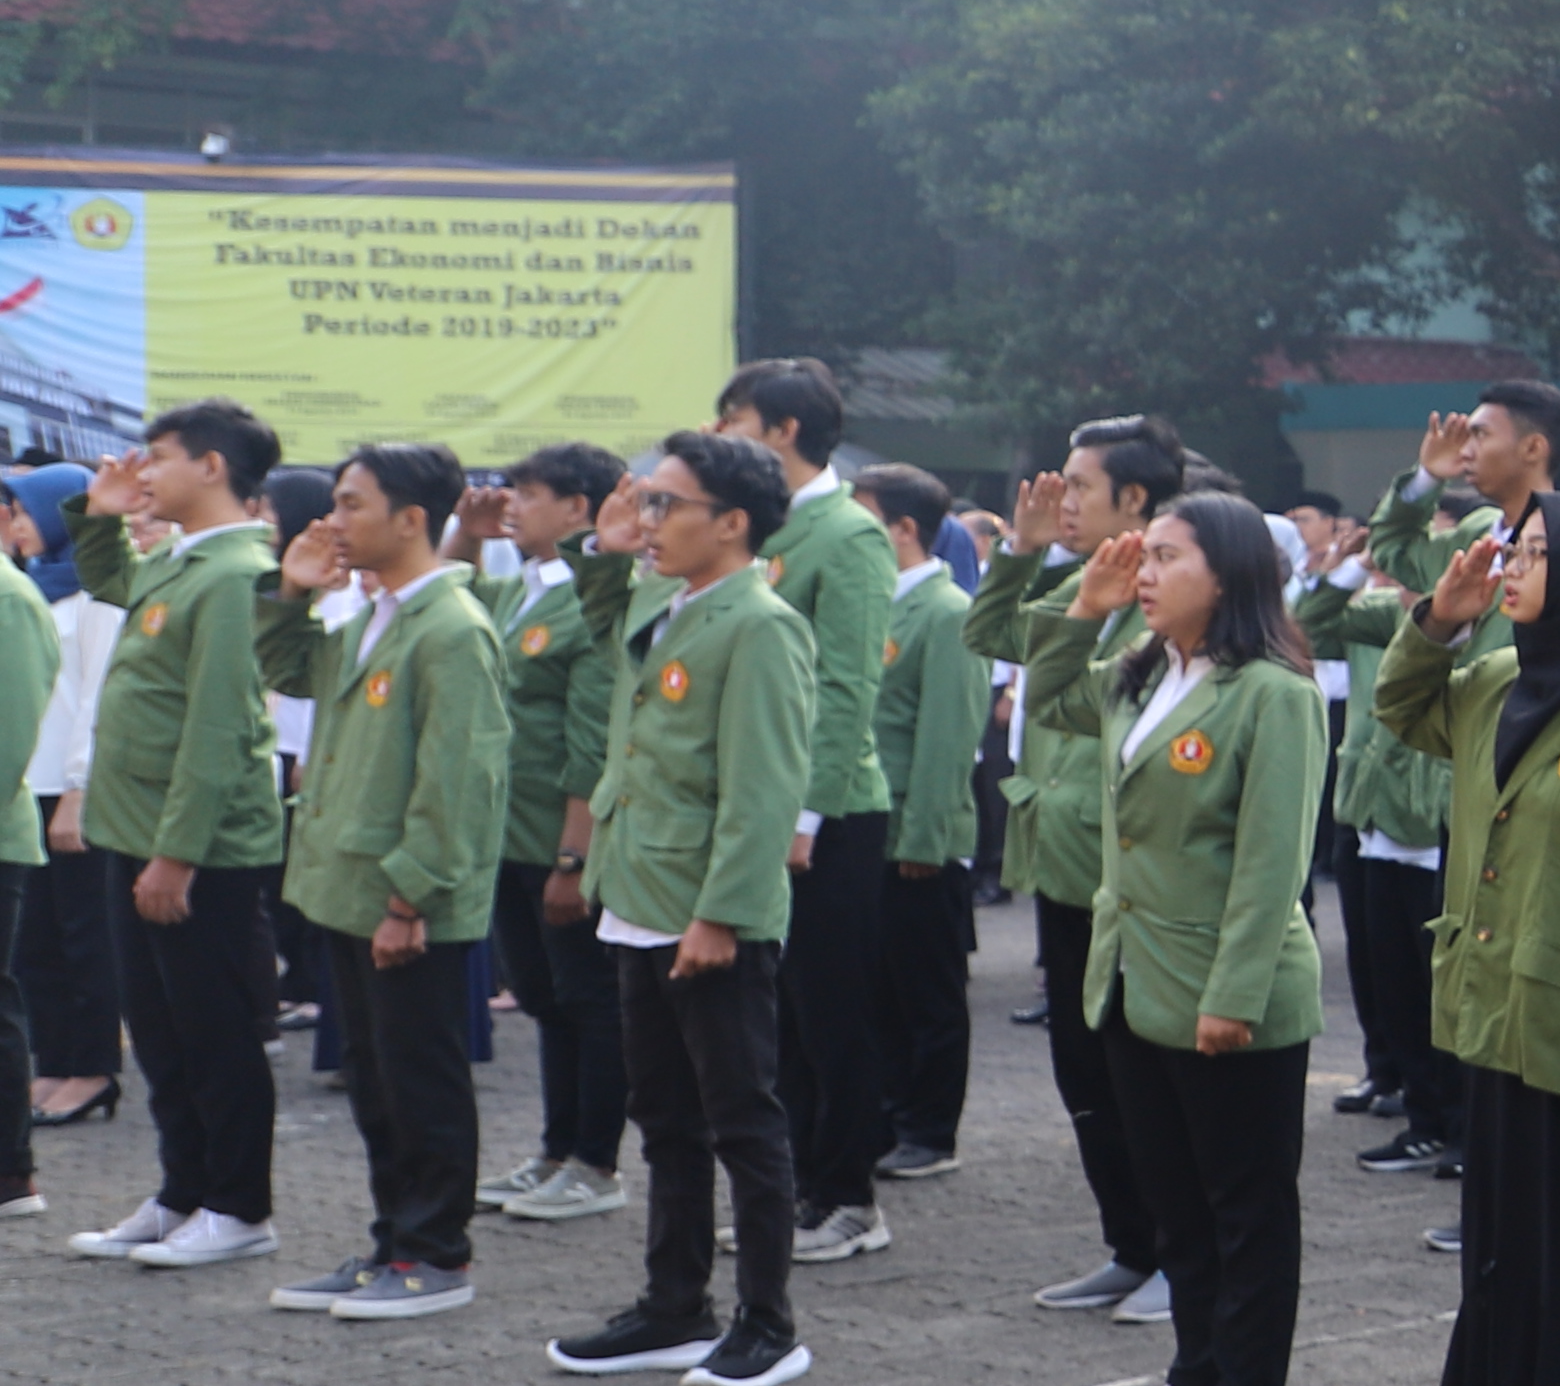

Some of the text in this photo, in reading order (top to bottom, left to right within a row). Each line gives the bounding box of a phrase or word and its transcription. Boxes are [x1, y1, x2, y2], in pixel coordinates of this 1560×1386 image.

[449, 217, 585, 242] menjadi
[596, 219, 701, 239] Dekan
[214, 243, 693, 273] Fakultas Ekonomi dan Bisnis
[289, 279, 621, 308] UPN Veteran Jakarta
[303, 314, 430, 336] Periode
